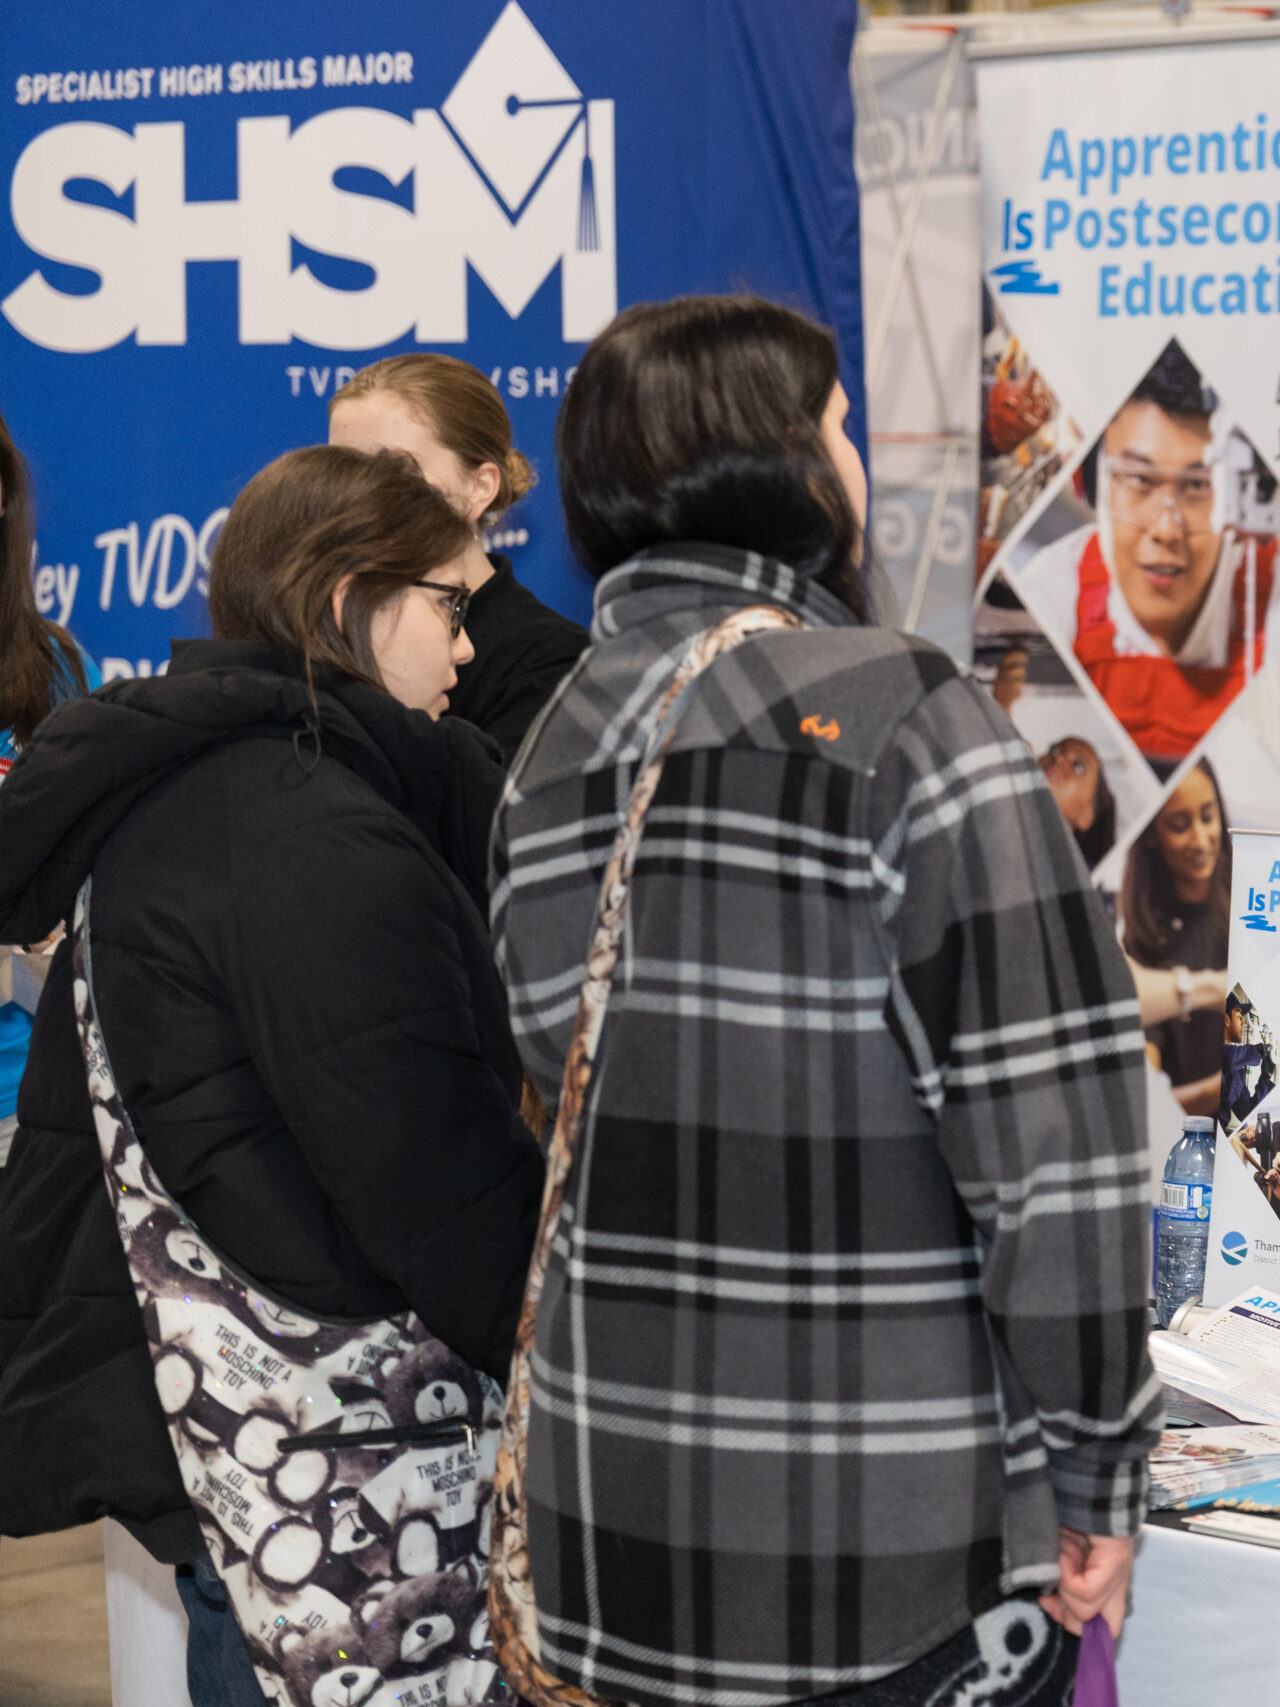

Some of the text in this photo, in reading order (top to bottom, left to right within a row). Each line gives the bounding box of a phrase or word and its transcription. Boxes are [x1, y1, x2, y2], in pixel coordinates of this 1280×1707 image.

[16, 52, 414, 105] SPECIALIST HIGH SKILLS MAJOR
[0, 98, 617, 352] SHSM
[1002, 198, 1035, 252] Is
[30, 536, 80, 628] ey
[1248, 888, 1265, 911] Is
[1253, 1255, 1277, 1265] District
[1249, 1313, 1279, 1328] MOTIVE
[215, 1323, 241, 1349] THIS
[243, 1343, 258, 1359] IS
[259, 1355, 285, 1376] NOT
[217, 1345, 274, 1390] MOSCHINO
[223, 1368, 247, 1391] TOY
[416, 1460, 441, 1480] THIS
